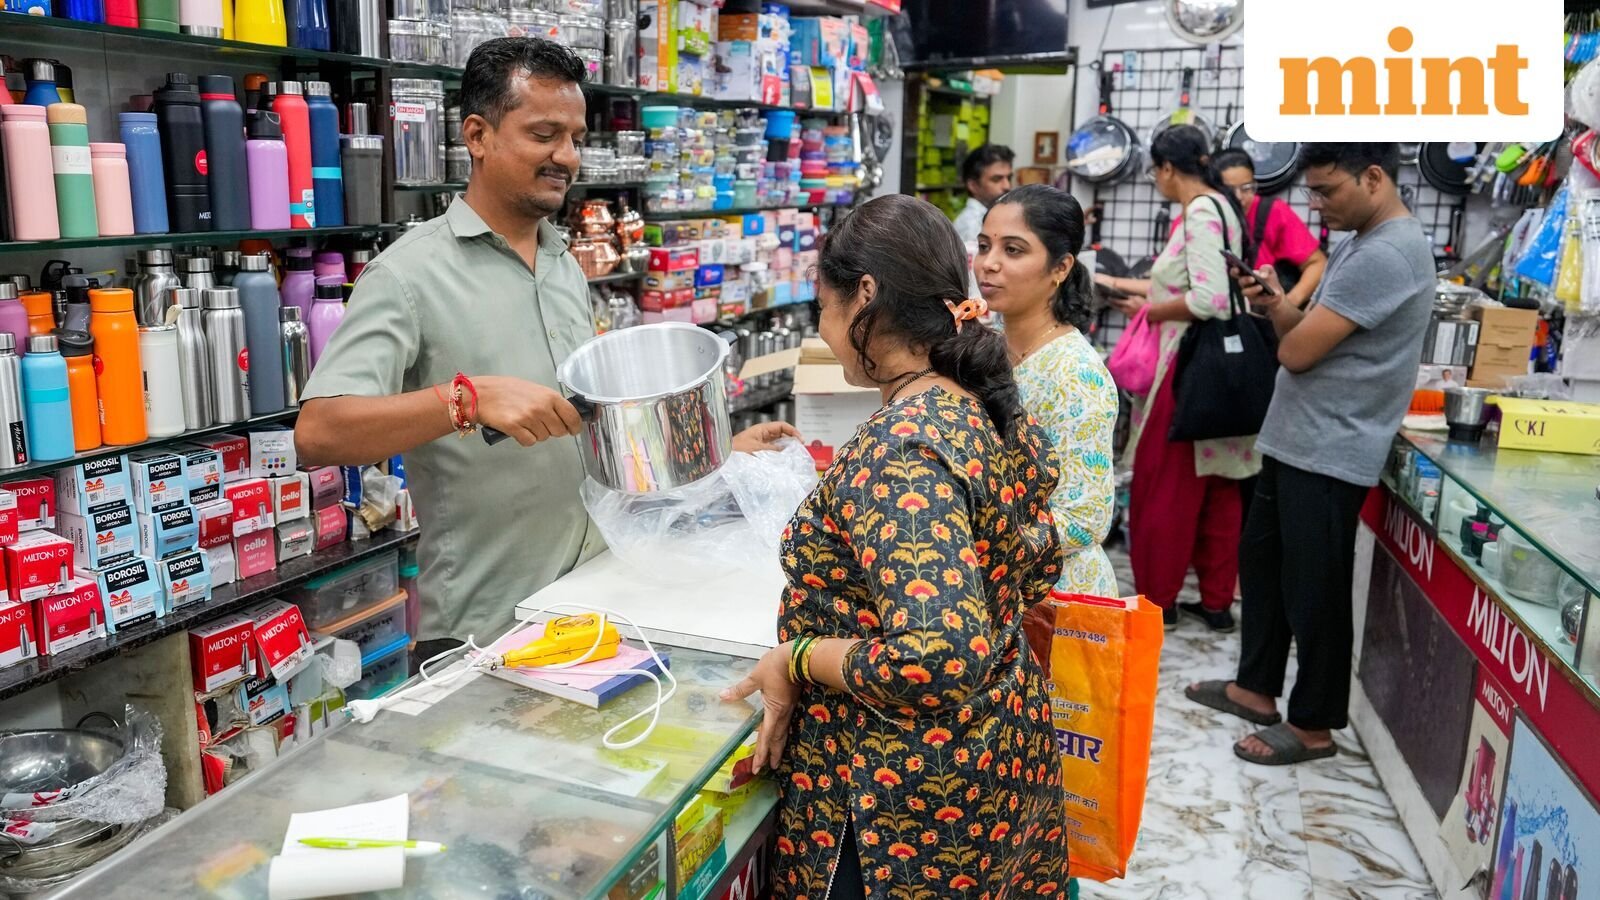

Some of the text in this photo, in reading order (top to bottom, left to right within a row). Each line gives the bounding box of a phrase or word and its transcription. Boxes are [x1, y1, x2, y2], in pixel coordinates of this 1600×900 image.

[84, 457, 119, 471] BOROSIL
[149, 461, 179, 474] BOROSIL
[233, 489, 254, 500] MILTON
[281, 491, 300, 502] cello
[95, 509, 129, 524] BOROSIL
[162, 510, 191, 522] BOROSIL
[0, 534, 14, 543] MIL
[244, 538, 267, 552] cello
[1384, 504, 1434, 582] MILTON
[23, 550, 54, 563] MILTON
[169, 557, 200, 573] BOROSIL
[107, 565, 145, 583] BOROSIL
[49, 595, 80, 613] MILTON
[261, 621, 288, 642] MILTON
[1055, 627, 1106, 644] 83737484
[208, 635, 238, 653] MILTON
[1467, 584, 1549, 713] MILTON
[1482, 680, 1510, 725] MILTON
[1056, 728, 1103, 763] झार
